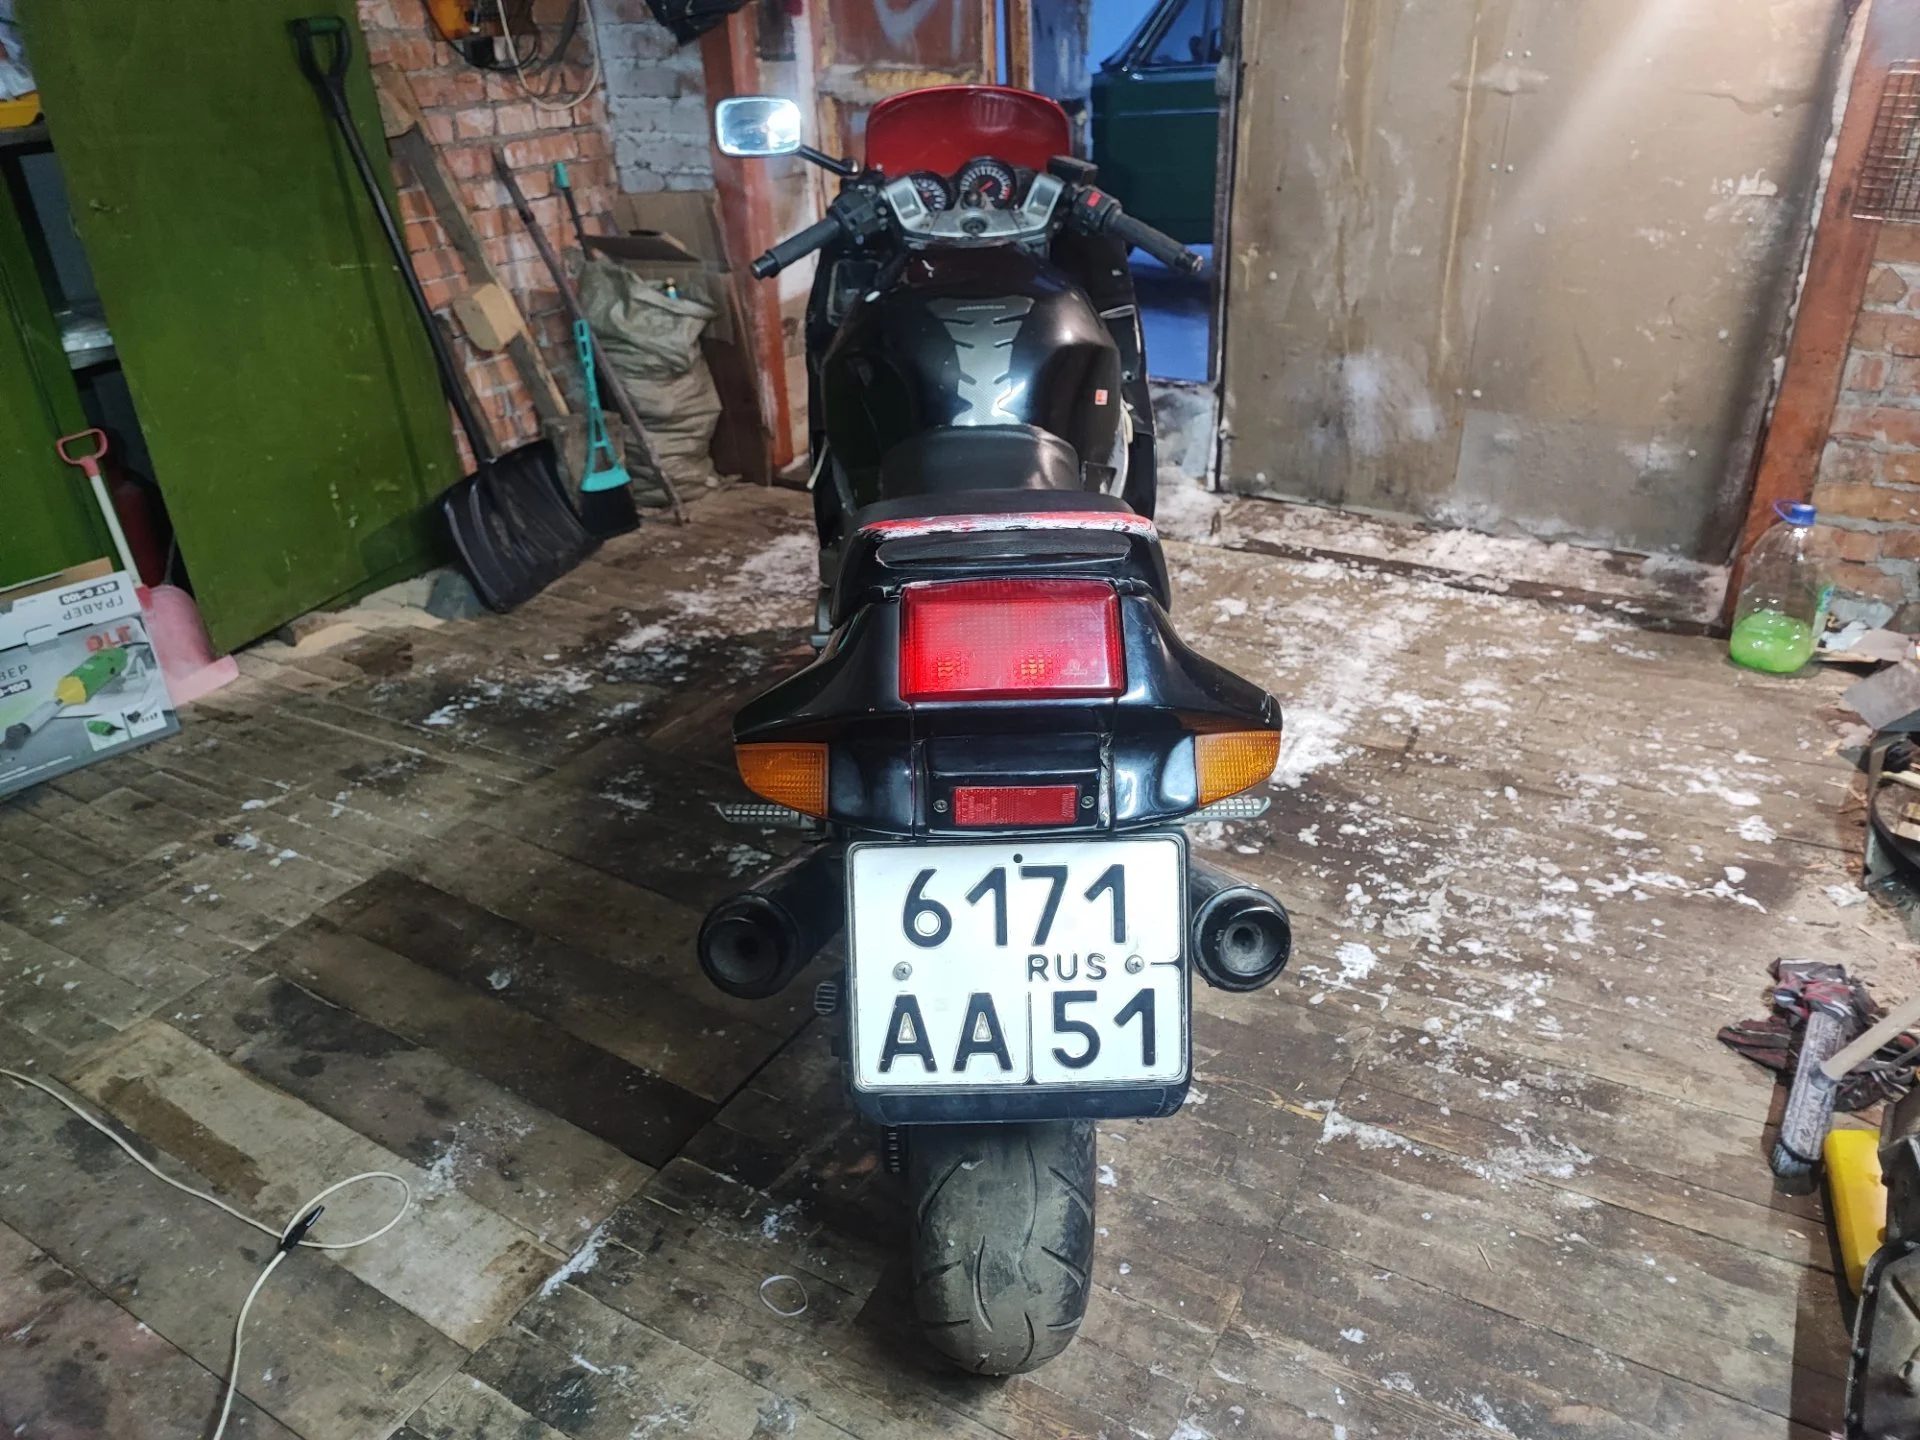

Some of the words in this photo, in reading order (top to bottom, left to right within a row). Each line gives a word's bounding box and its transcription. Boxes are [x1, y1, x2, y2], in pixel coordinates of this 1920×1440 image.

[62, 595, 124, 621] ГРАВЕР
[902, 864, 1126, 948] 6171
[1027, 952, 1107, 982] RUS
[1051, 988, 1156, 1069] 51
